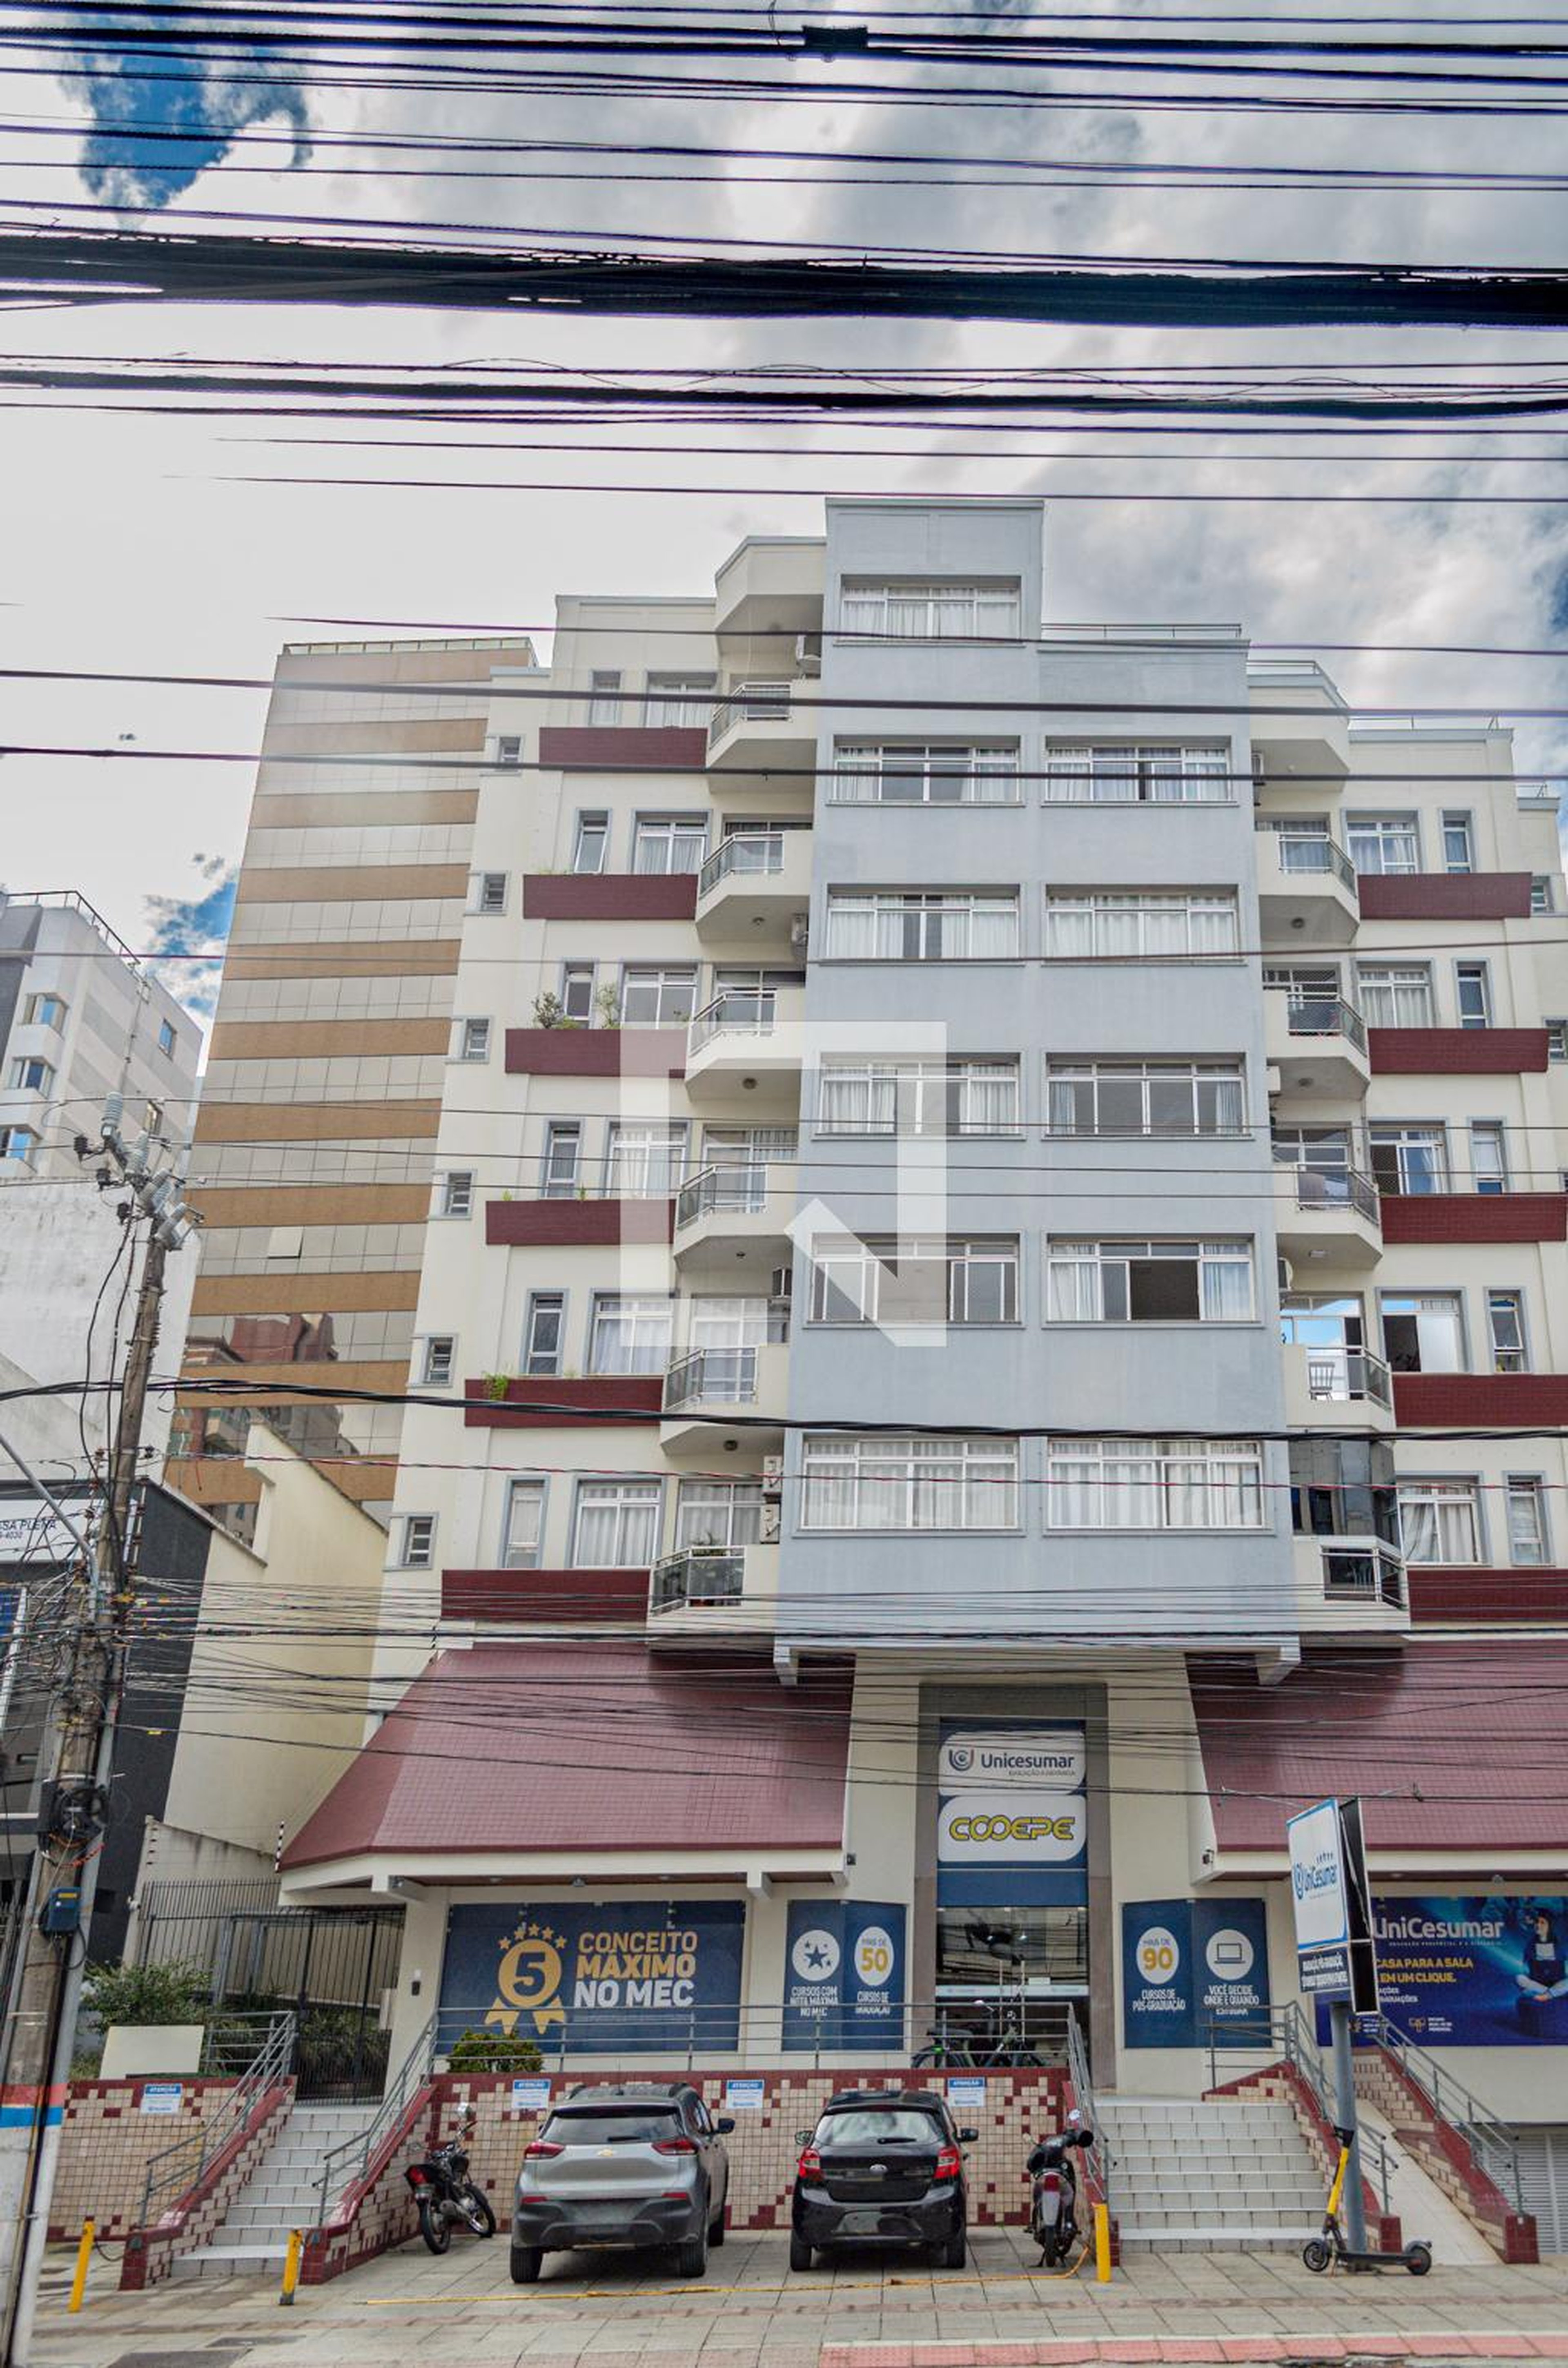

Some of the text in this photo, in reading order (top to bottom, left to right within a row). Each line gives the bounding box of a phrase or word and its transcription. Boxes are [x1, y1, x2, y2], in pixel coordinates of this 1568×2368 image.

[0, 1520, 17, 1531] SA
[981, 1753, 1075, 1768] Unicesumar
[1373, 1917, 1504, 1939] UniCesumar
[578, 1931, 698, 1953] CONCEITO
[861, 1947, 889, 1972] 50
[1143, 1947, 1174, 1971] 90
[1404, 1958, 1434, 1969] PARA
[512, 1951, 546, 1996] 5
[574, 1979, 695, 2008] NO MEC
